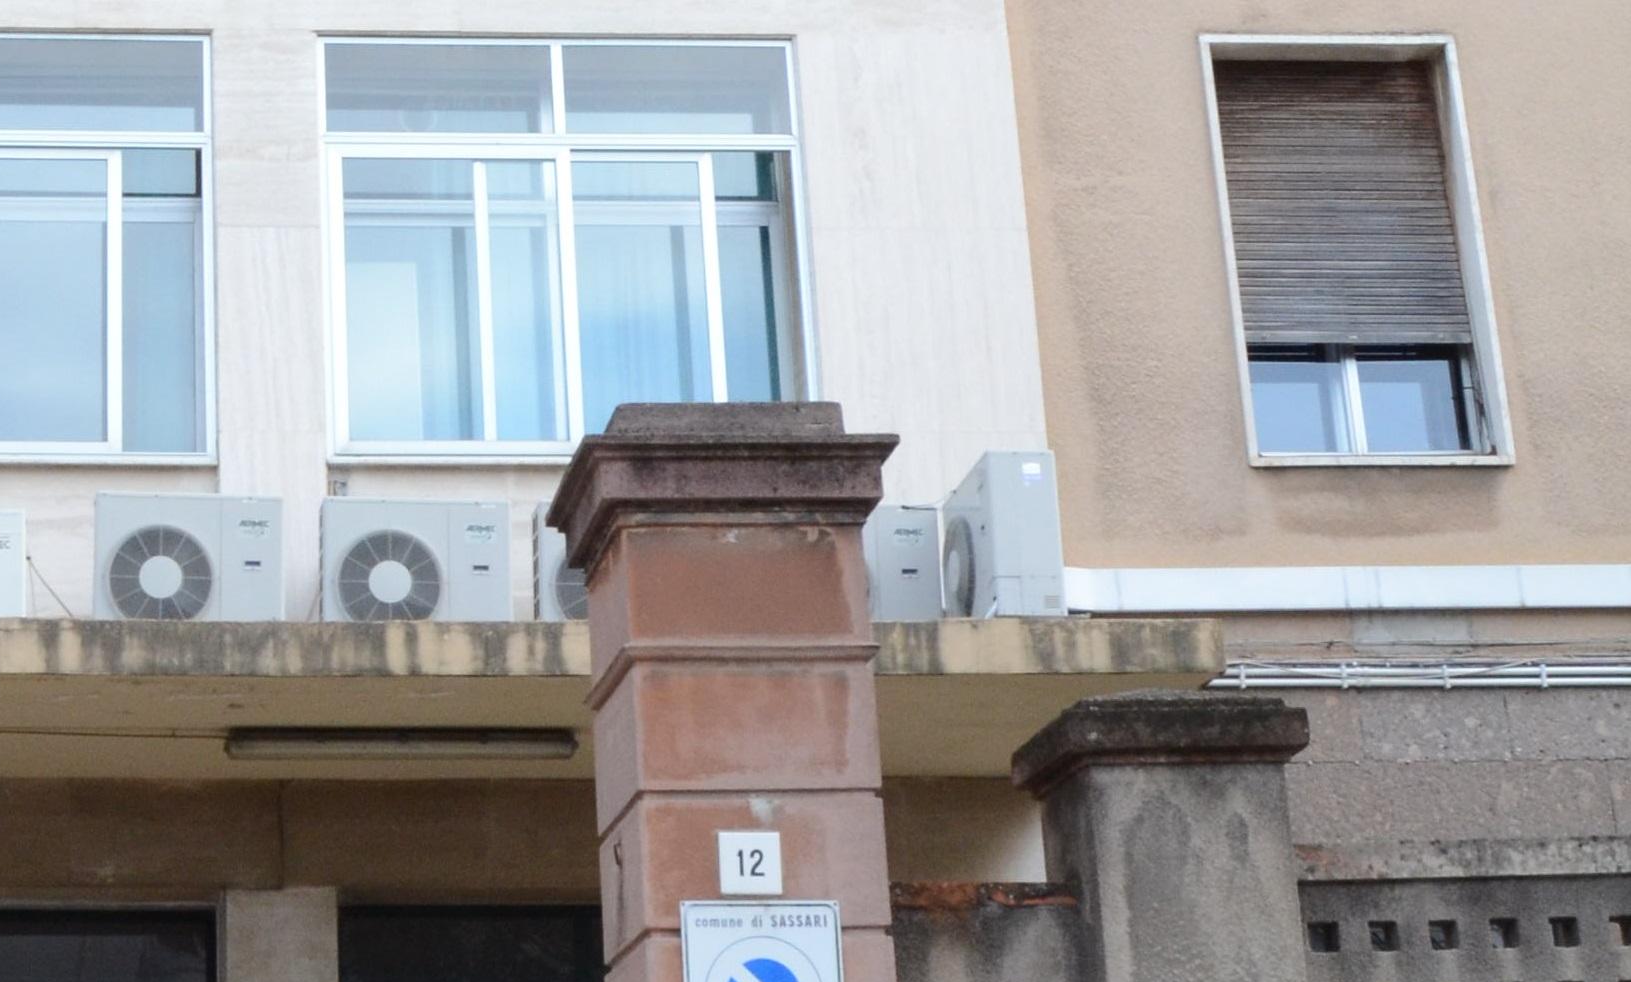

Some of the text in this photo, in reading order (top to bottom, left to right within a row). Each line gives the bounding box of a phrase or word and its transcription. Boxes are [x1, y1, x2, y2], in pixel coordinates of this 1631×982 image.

[736, 848, 766, 877] 12
[695, 914, 828, 928] comune di SASSARI
